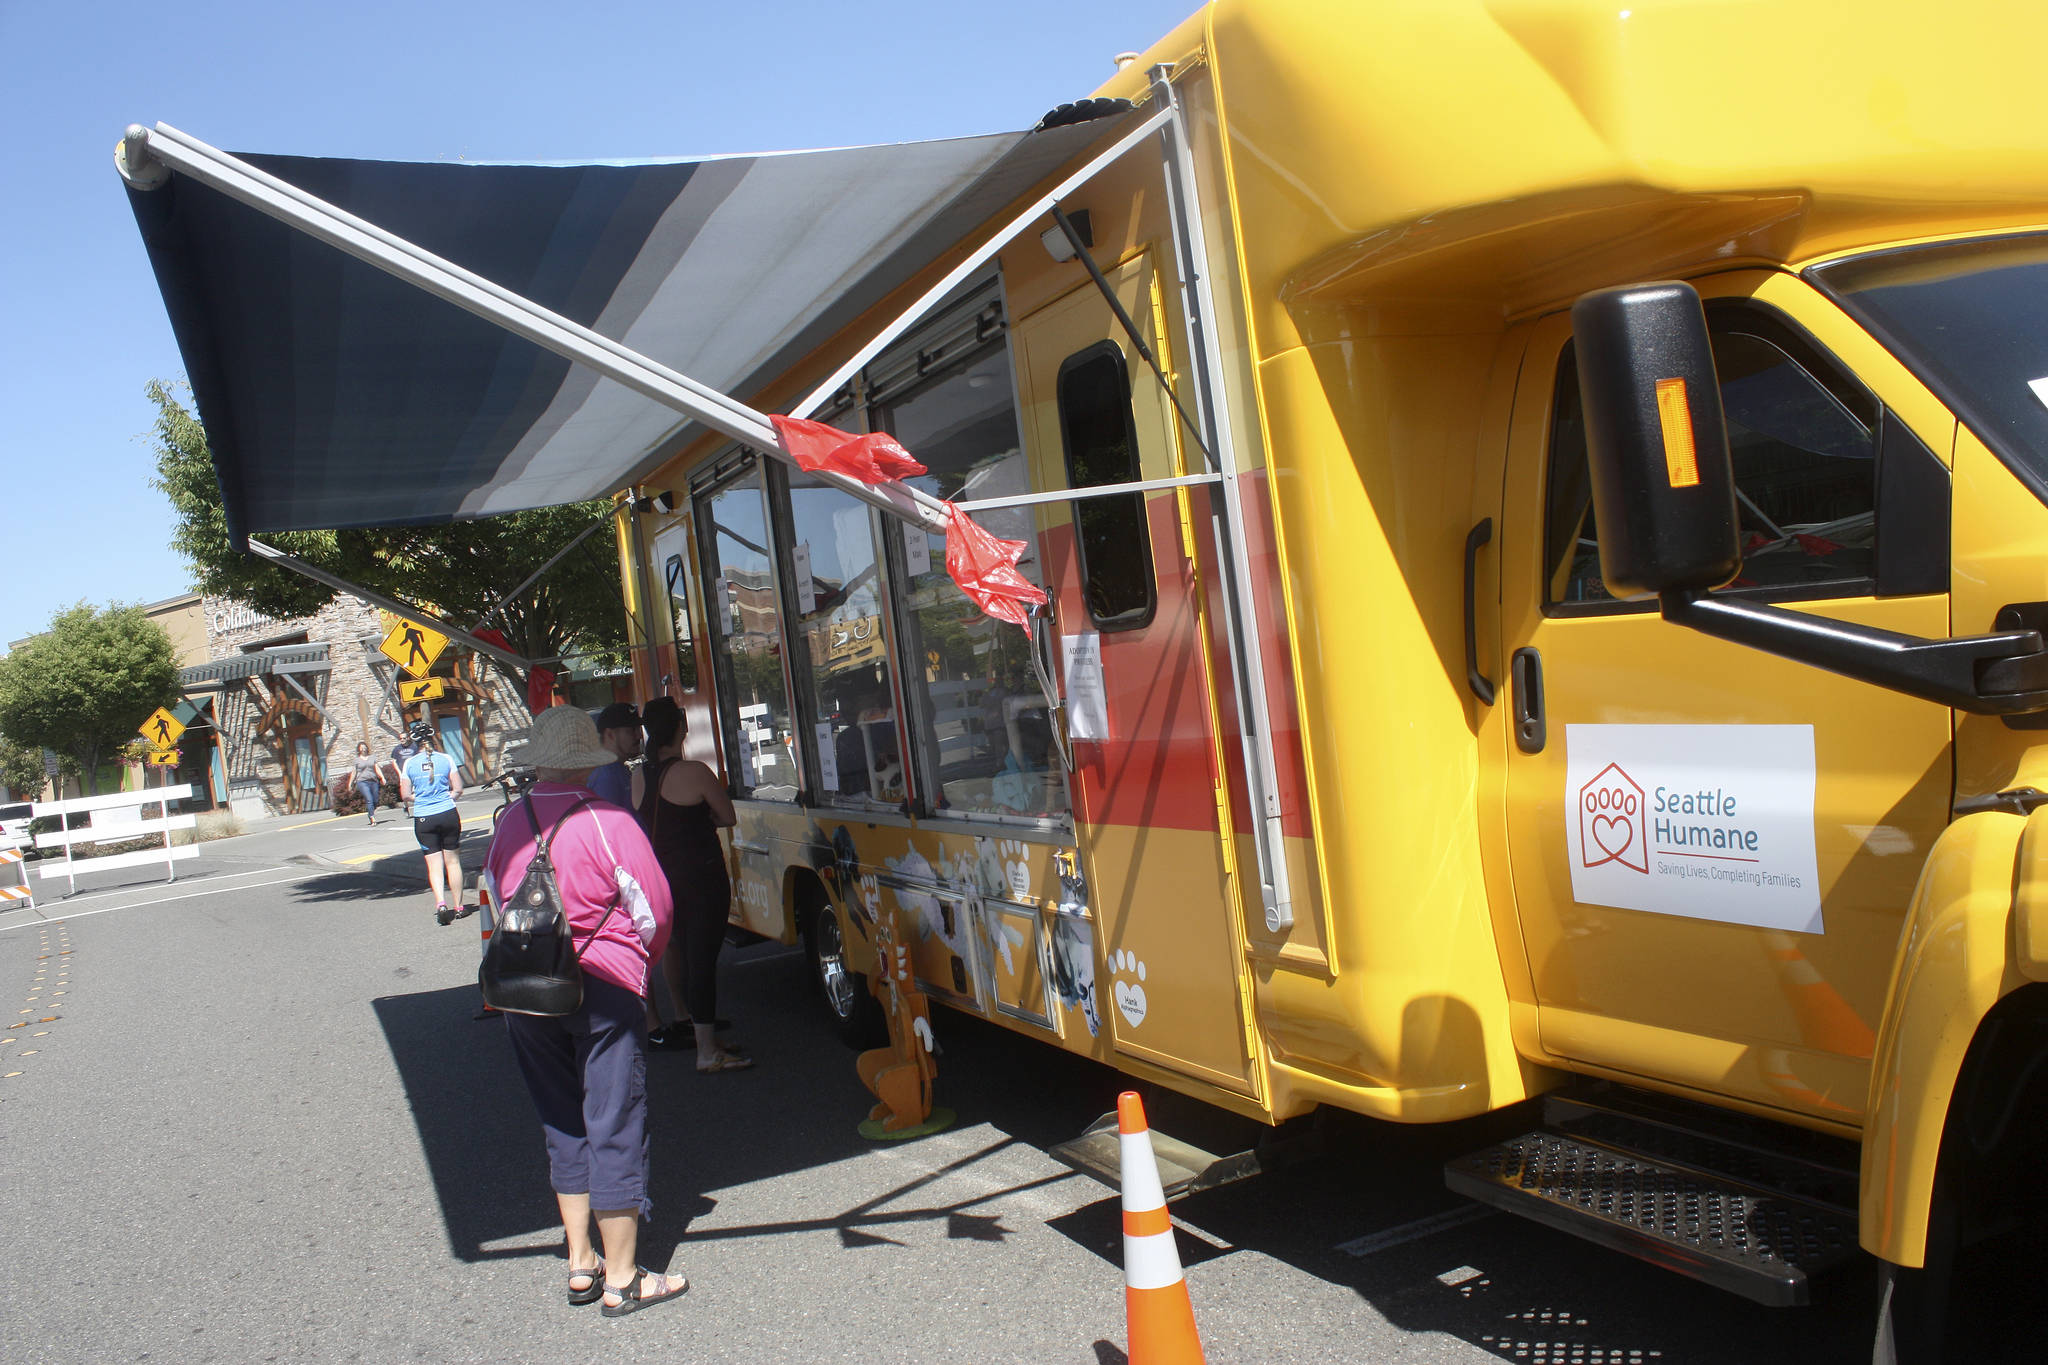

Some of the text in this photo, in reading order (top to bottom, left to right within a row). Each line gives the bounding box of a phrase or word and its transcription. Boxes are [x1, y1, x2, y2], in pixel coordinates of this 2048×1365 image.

[1654, 786, 1736, 817] Seattle
[1654, 817, 1759, 851] Humane
[1657, 861, 1801, 889] Saving Lives, Completing Families
